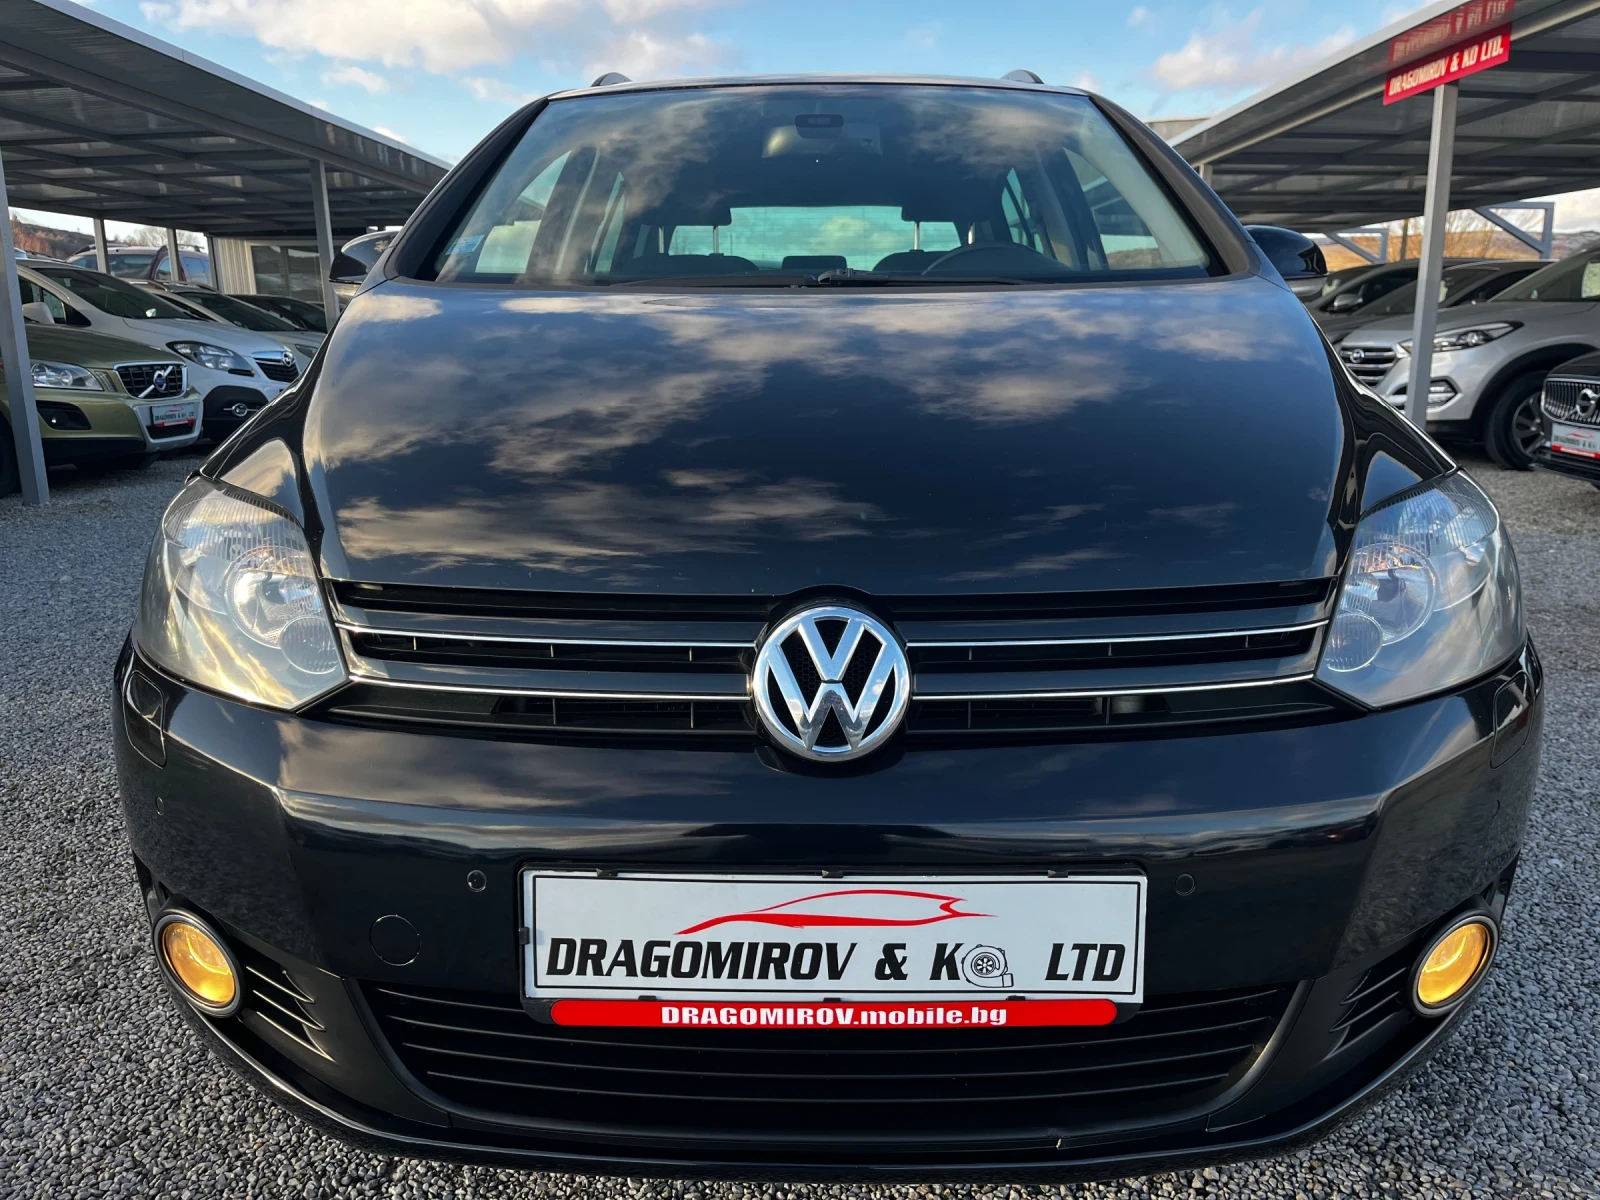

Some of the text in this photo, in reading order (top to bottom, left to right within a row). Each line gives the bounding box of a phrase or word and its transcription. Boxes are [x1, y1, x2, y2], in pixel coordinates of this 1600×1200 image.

[545, 937, 858, 981] DRAGOMIROV
[874, 942, 909, 981] &
[1045, 942, 1127, 982] LTD
[661, 1006, 1008, 1026] DRAGOMIROV.mobile.bg
